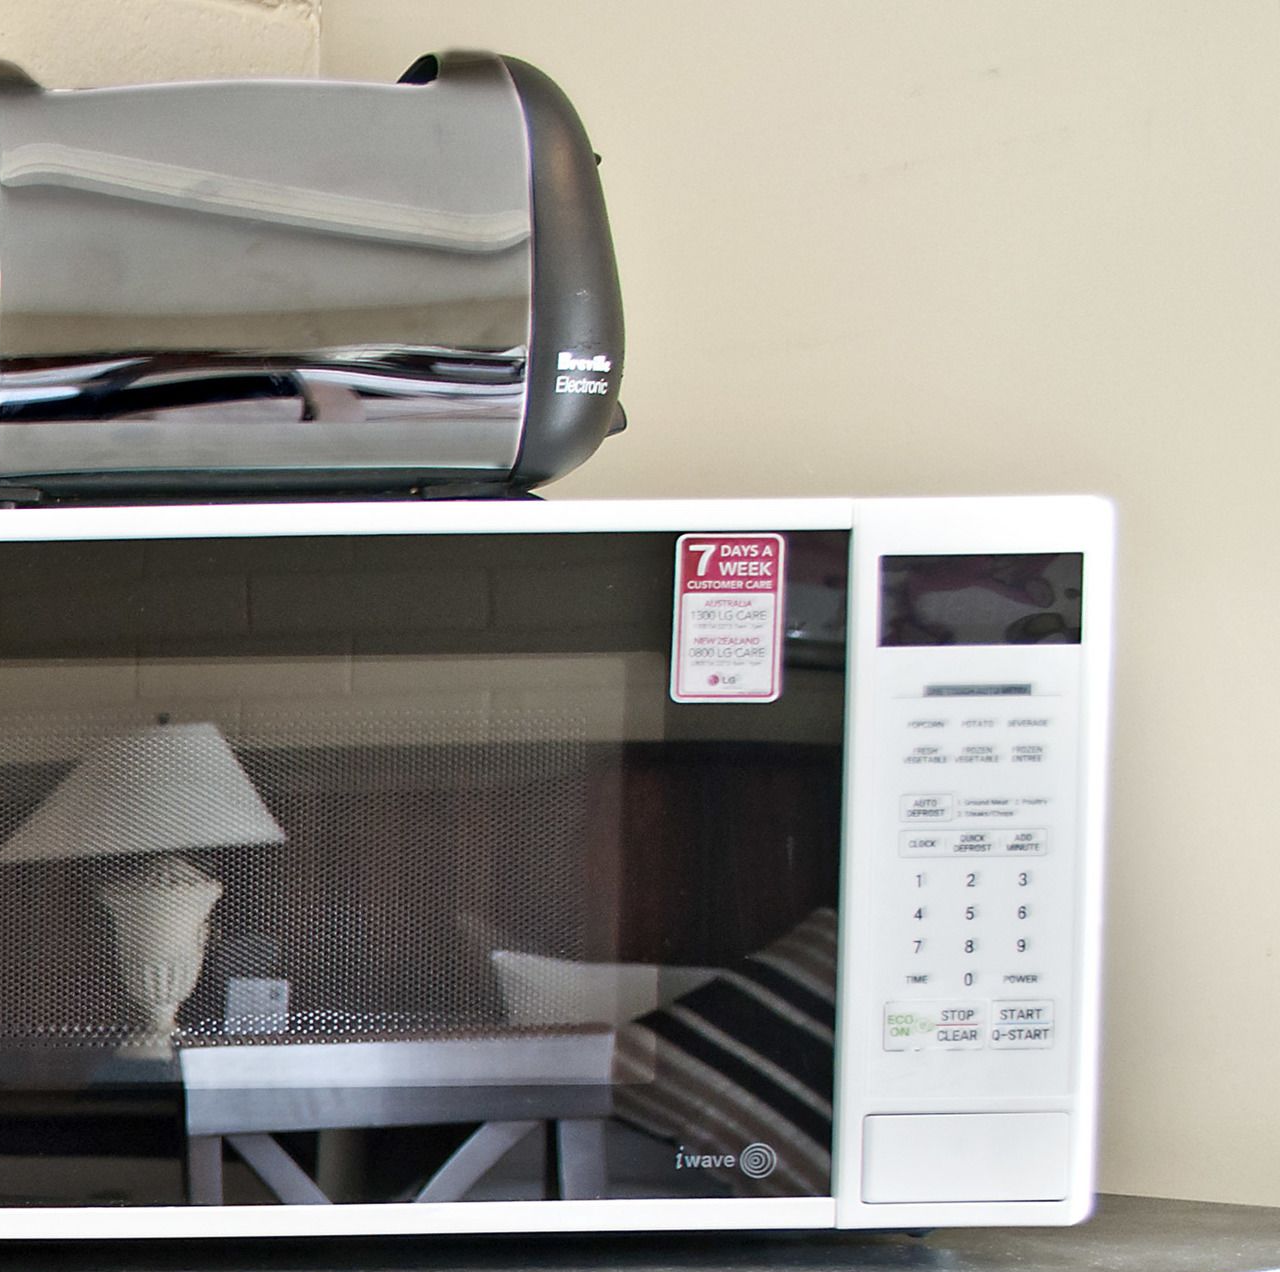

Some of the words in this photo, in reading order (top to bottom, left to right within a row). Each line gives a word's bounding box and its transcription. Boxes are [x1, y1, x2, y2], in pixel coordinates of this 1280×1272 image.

[556, 376, 608, 394] Electronic
[720, 545, 758, 557] DAYS
[762, 546, 773, 557] A
[689, 544, 716, 576] 7
[719, 562, 772, 576] WEEK
[687, 580, 743, 589] CUSTOMER
[745, 581, 773, 589] CARE
[736, 610, 767, 620] CARE
[913, 799, 937, 807] AUTO
[909, 840, 936, 848] CLOCK
[915, 874, 922, 888] 1
[966, 873, 976, 887] 2
[1018, 872, 1028, 886] 3
[913, 908, 923, 920] 4
[965, 906, 975, 920] 5
[1018, 905, 1027, 919] 6
[913, 941, 922, 954] 7
[964, 939, 974, 953] 8
[1017, 938, 1026, 952] 9
[906, 975, 928, 984] TIME
[964, 972, 973, 986] 0
[1003, 974, 1038, 984] POWER
[888, 1015, 914, 1025] ECO
[942, 1009, 975, 1022] STOP
[1000, 1008, 1042, 1020] START
[890, 1027, 911, 1037] ON
[937, 1029, 977, 1041] CLEAR
[992, 1029, 1049, 1041] Q-START
